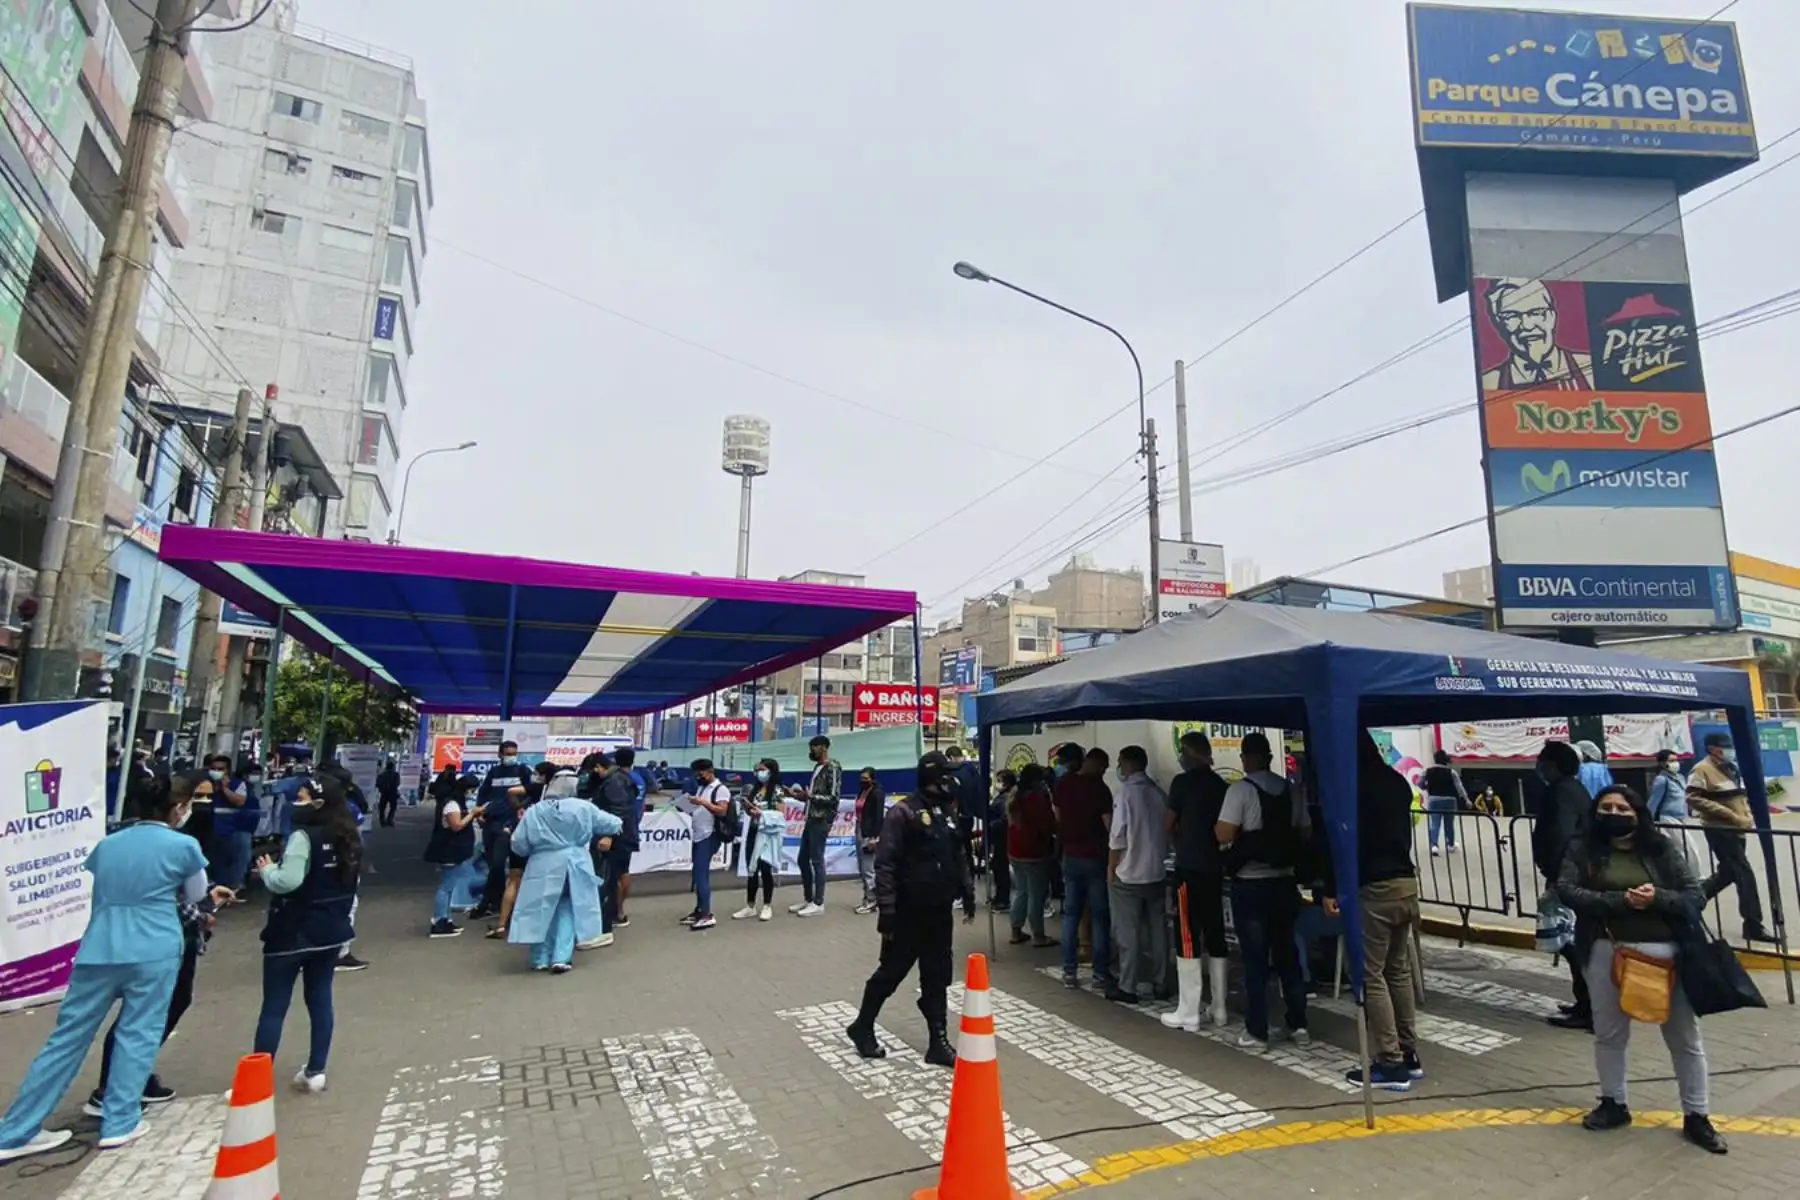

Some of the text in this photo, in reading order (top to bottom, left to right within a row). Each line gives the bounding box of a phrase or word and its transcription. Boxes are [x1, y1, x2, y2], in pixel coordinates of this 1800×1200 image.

[1428, 71, 1738, 121] Parque Cánepa
[1431, 112, 1500, 125] Centro
[1603, 319, 1688, 364] Pizza
[1618, 343, 1686, 375] Hut
[1515, 399, 1682, 441] Norky's
[1579, 466, 1690, 489] movistar
[1518, 577, 1696, 597] BBVA Continental
[1551, 609, 1669, 625] cajero automático
[1486, 659, 1538, 673] GERENCIA
[1496, 676, 1518, 689] SUB
[1519, 677, 1570, 689] GERENCIA
[877, 691, 934, 706] BAÑOS
[0, 805, 93, 838] AVICTORIA
[639, 828, 691, 842] TORIA
[74, 847, 89, 859] DE
[9, 874, 46, 892] SALUD
